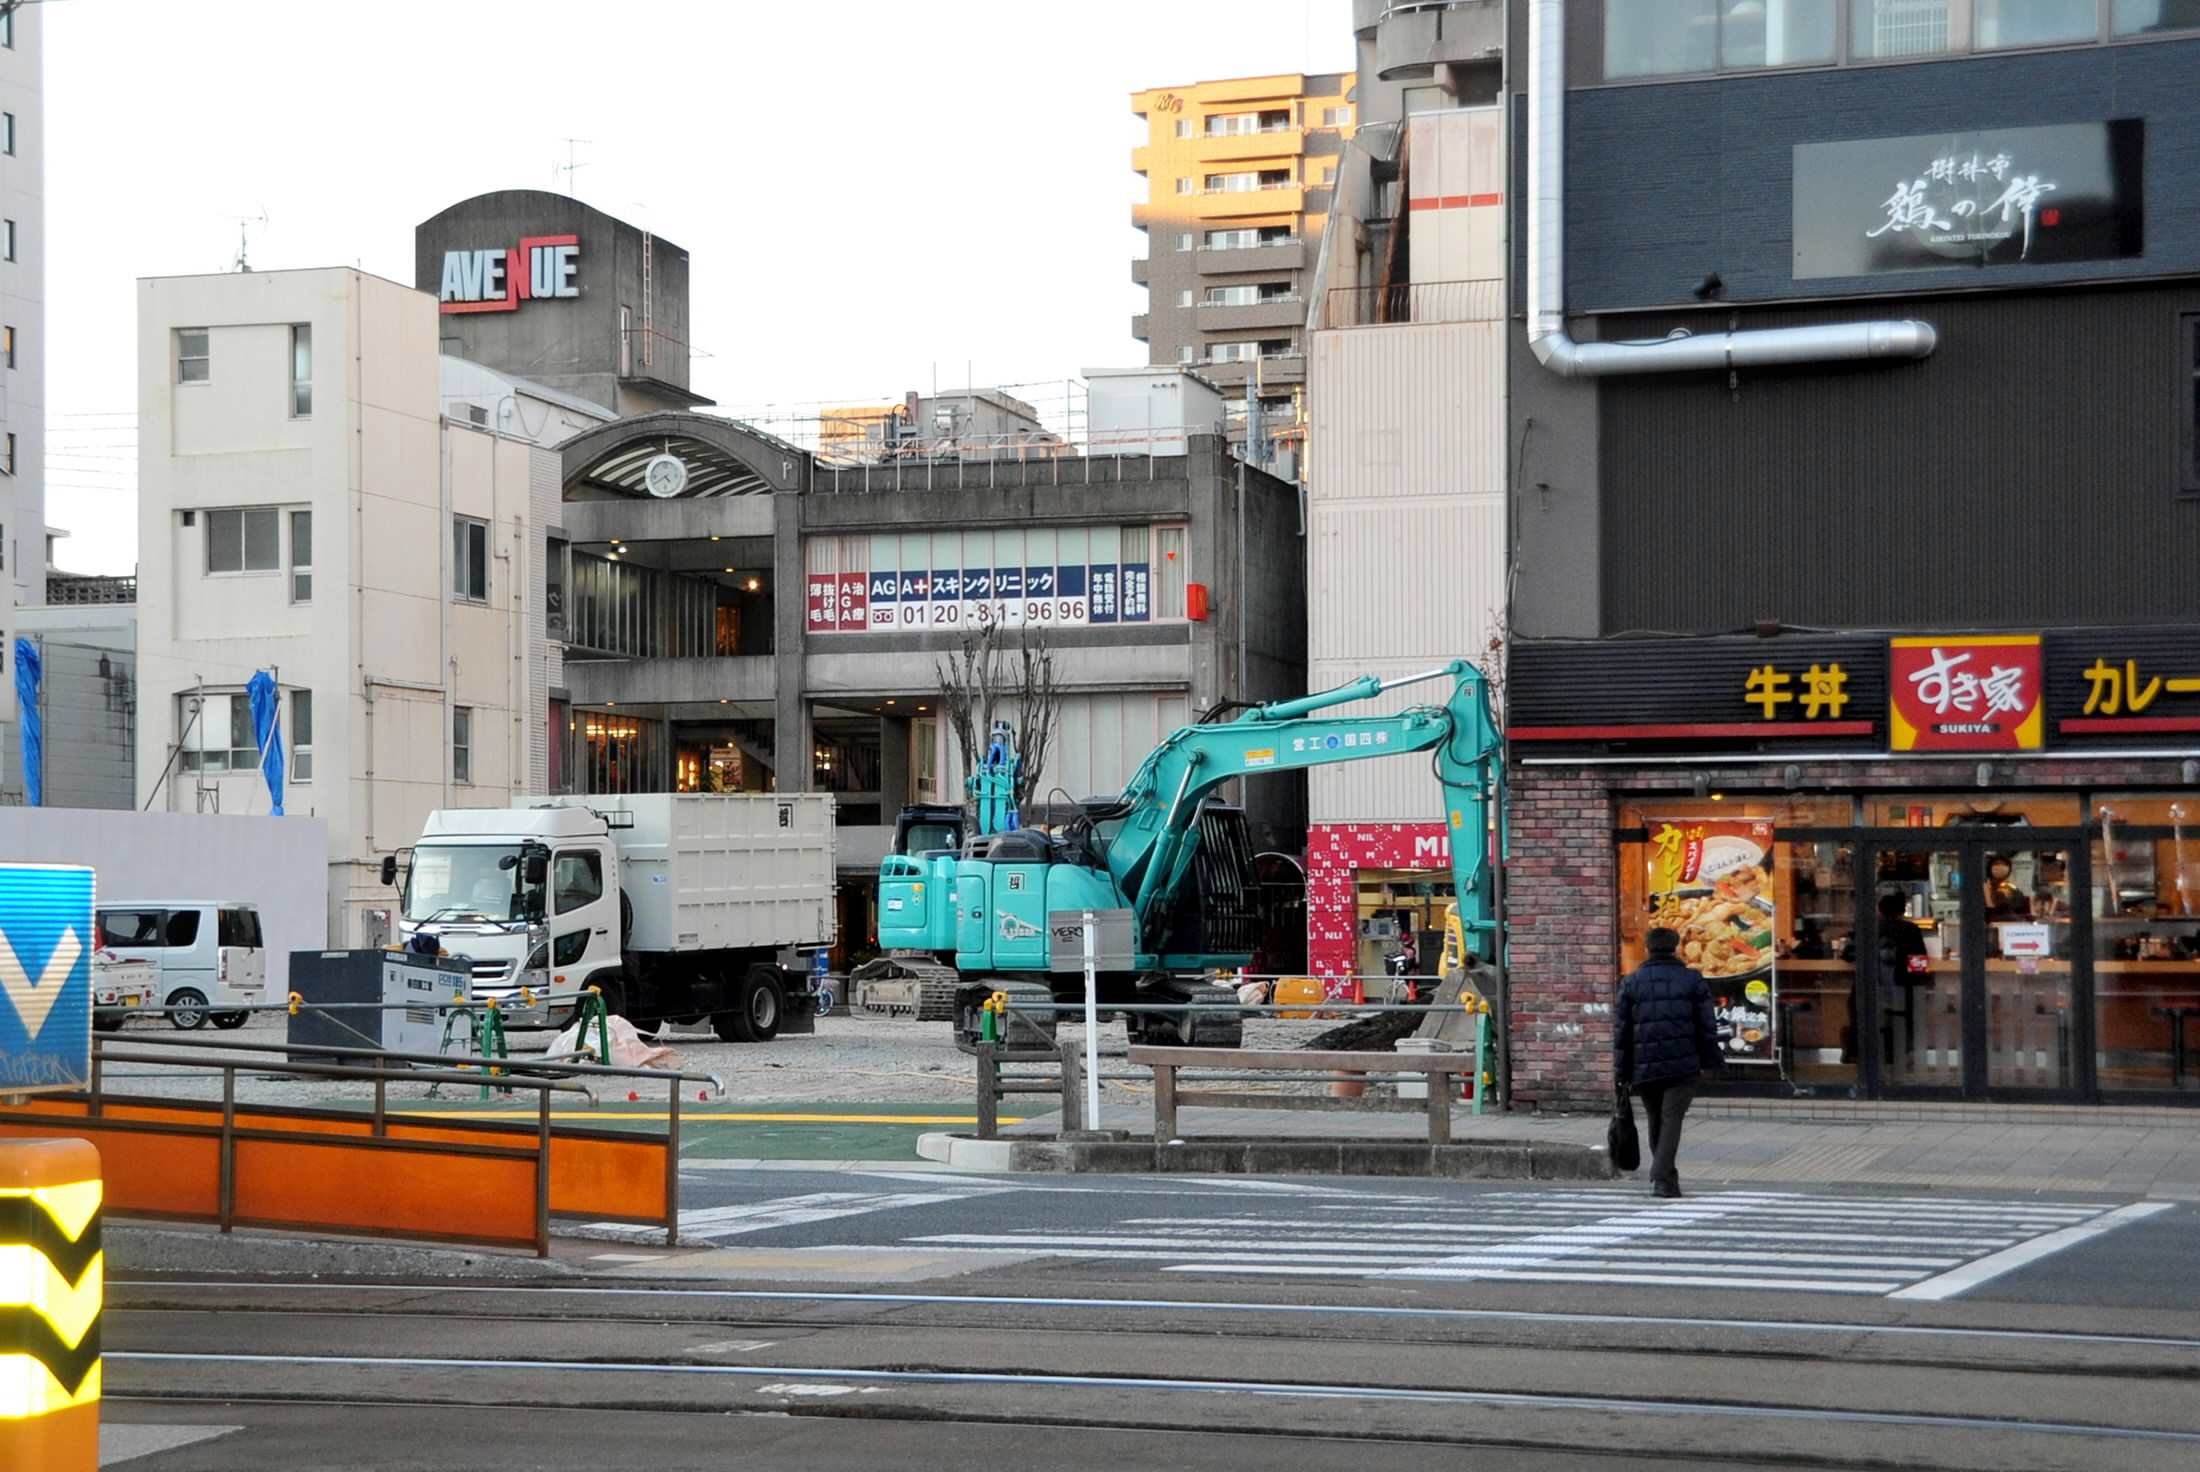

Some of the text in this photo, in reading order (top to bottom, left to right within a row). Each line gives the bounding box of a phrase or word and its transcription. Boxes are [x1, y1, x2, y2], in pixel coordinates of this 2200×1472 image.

[440, 235, 580, 313] AVENUE
[841, 583, 851, 621] AGA
[1745, 663, 1849, 719] 牛丼
[1908, 647, 2025, 721] すき家
[2083, 658, 2200, 715] カレー
[1939, 723, 1991, 734] SUKIYA
[1415, 837, 1449, 857] MI
